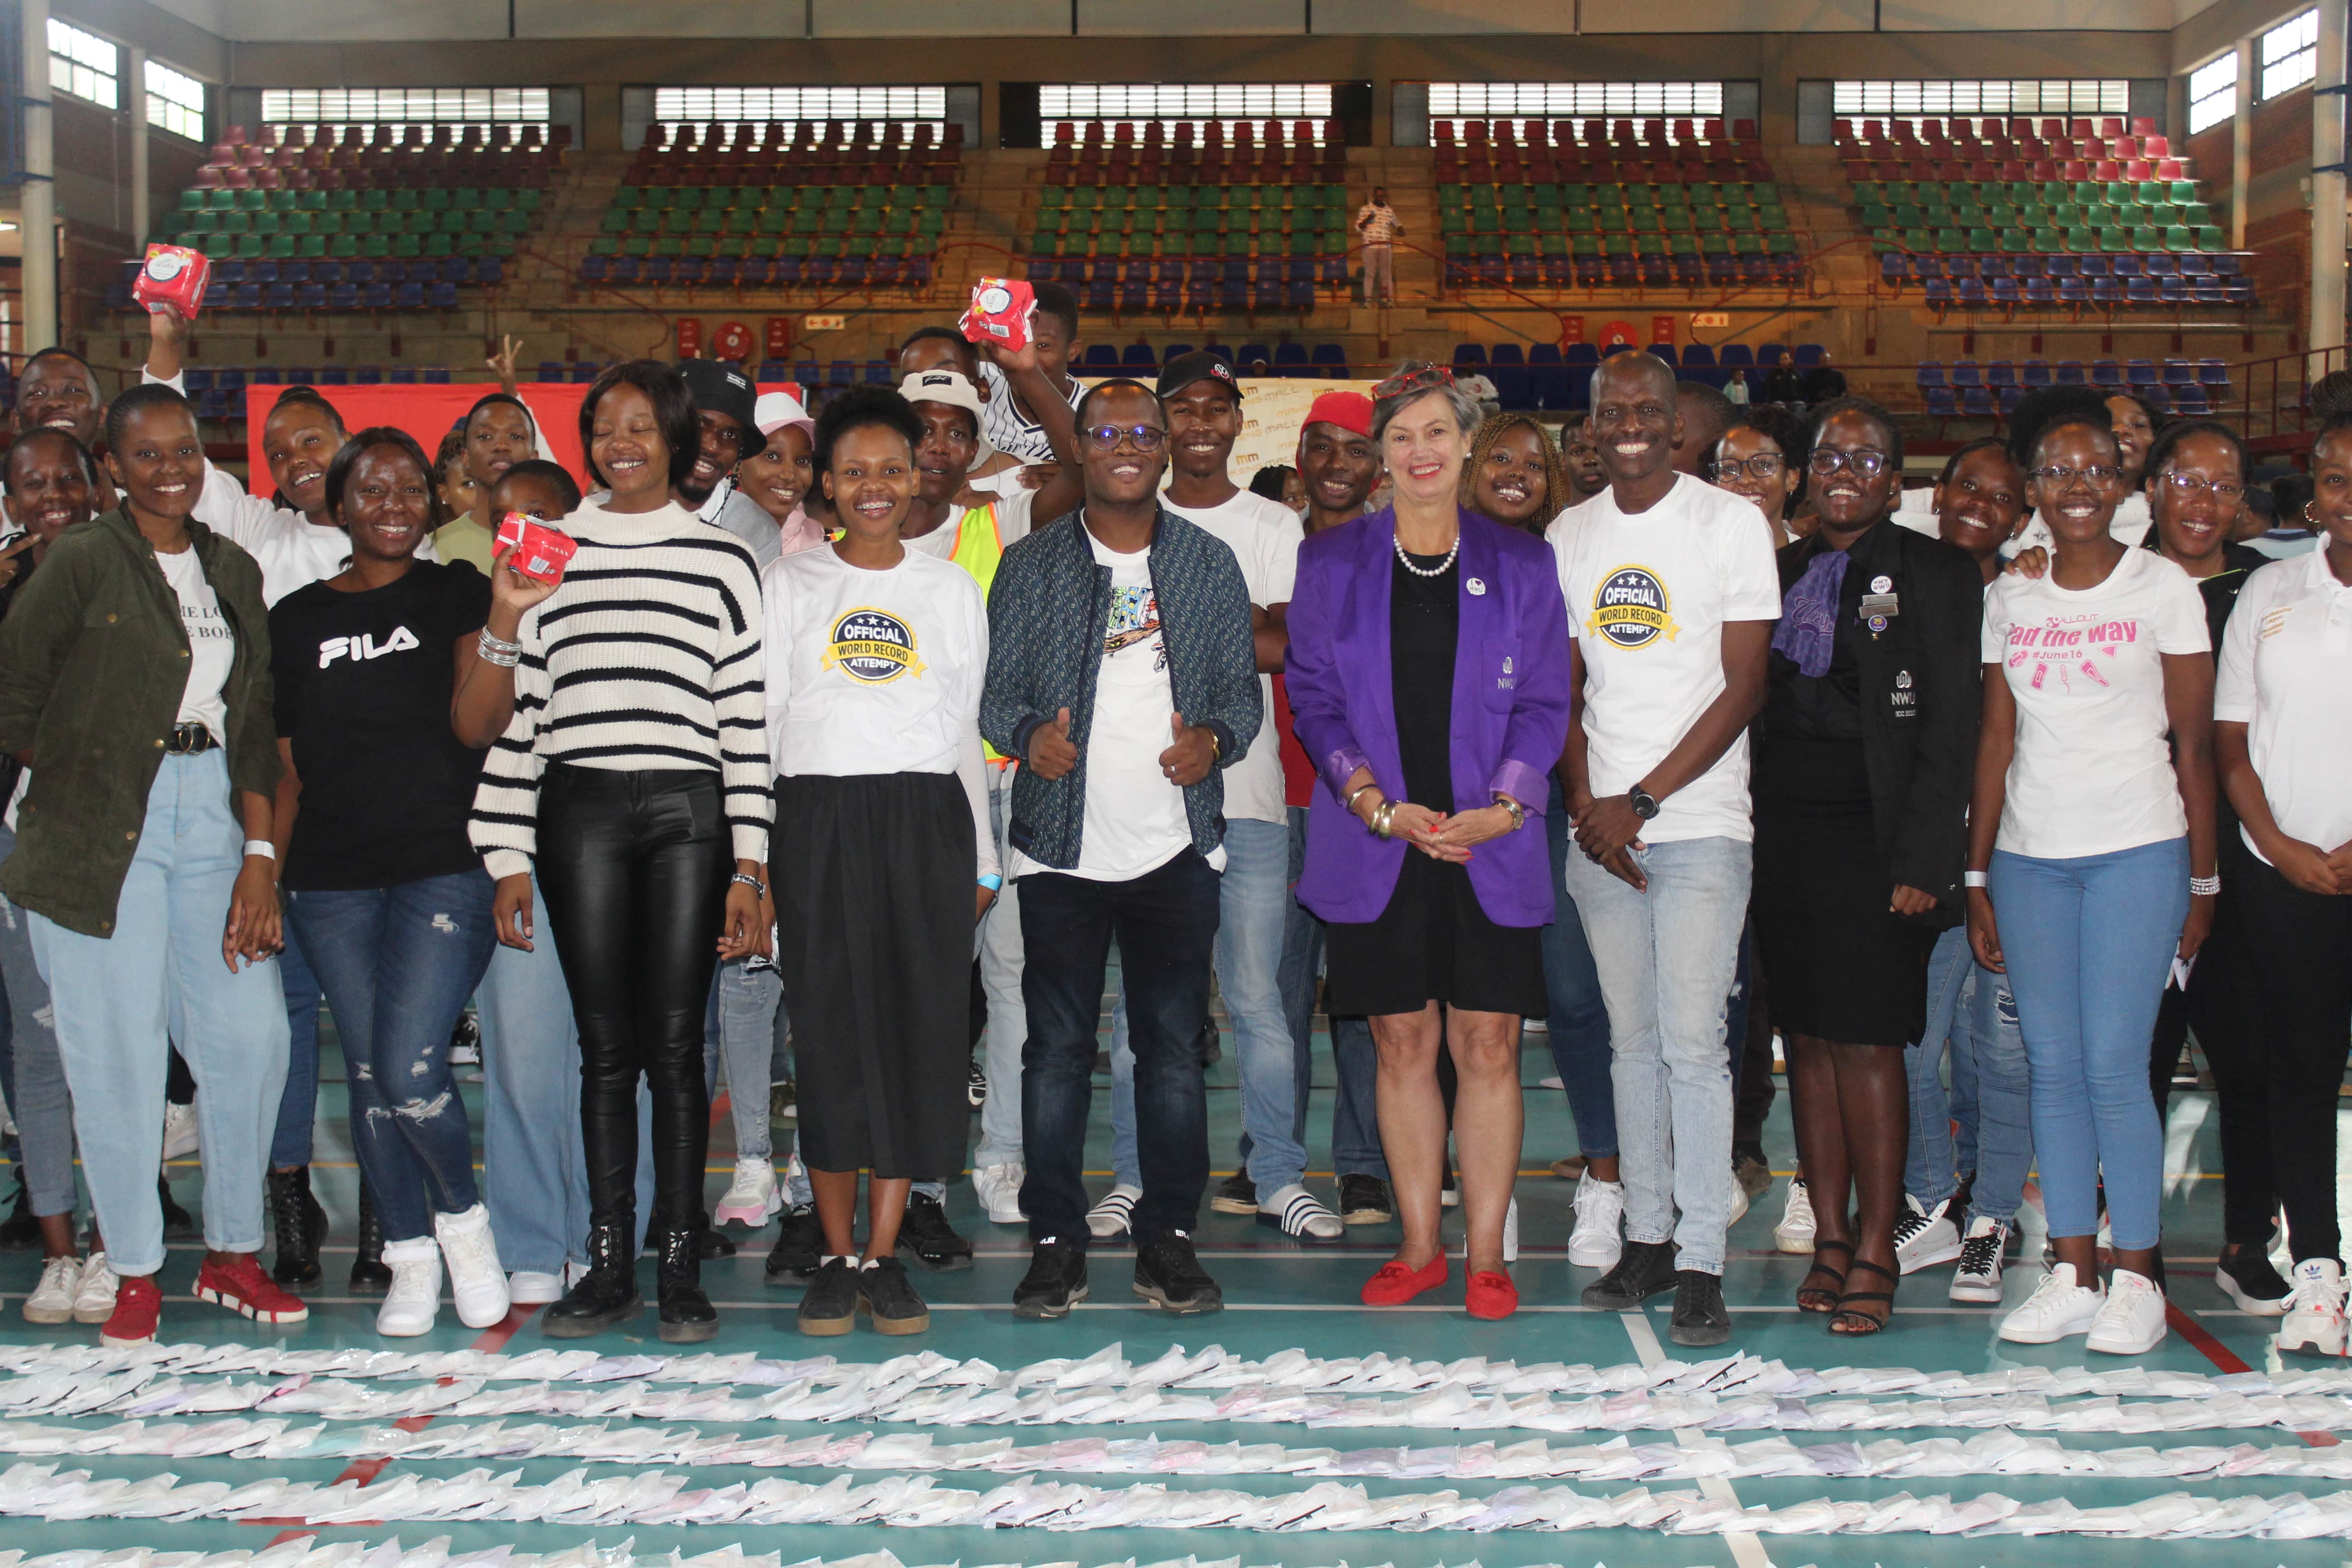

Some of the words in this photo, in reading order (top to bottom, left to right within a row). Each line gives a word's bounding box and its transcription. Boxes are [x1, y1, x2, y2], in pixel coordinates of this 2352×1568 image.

[1605, 587, 1657, 607] OFFICIAL
[1599, 608, 1628, 623] WORLD
[1631, 608, 1662, 625] RECORD
[844, 624, 902, 644] OFFICIAL
[1609, 623, 1651, 635] ATTEMPT
[2042, 630, 2082, 647] the
[2088, 621, 2136, 643] way
[319, 626, 420, 669] FILA
[838, 643, 871, 657] WORLD
[874, 643, 908, 662] RECORD
[850, 658, 896, 670] ATTEMPT
[1891, 692, 1915, 705] NWU
